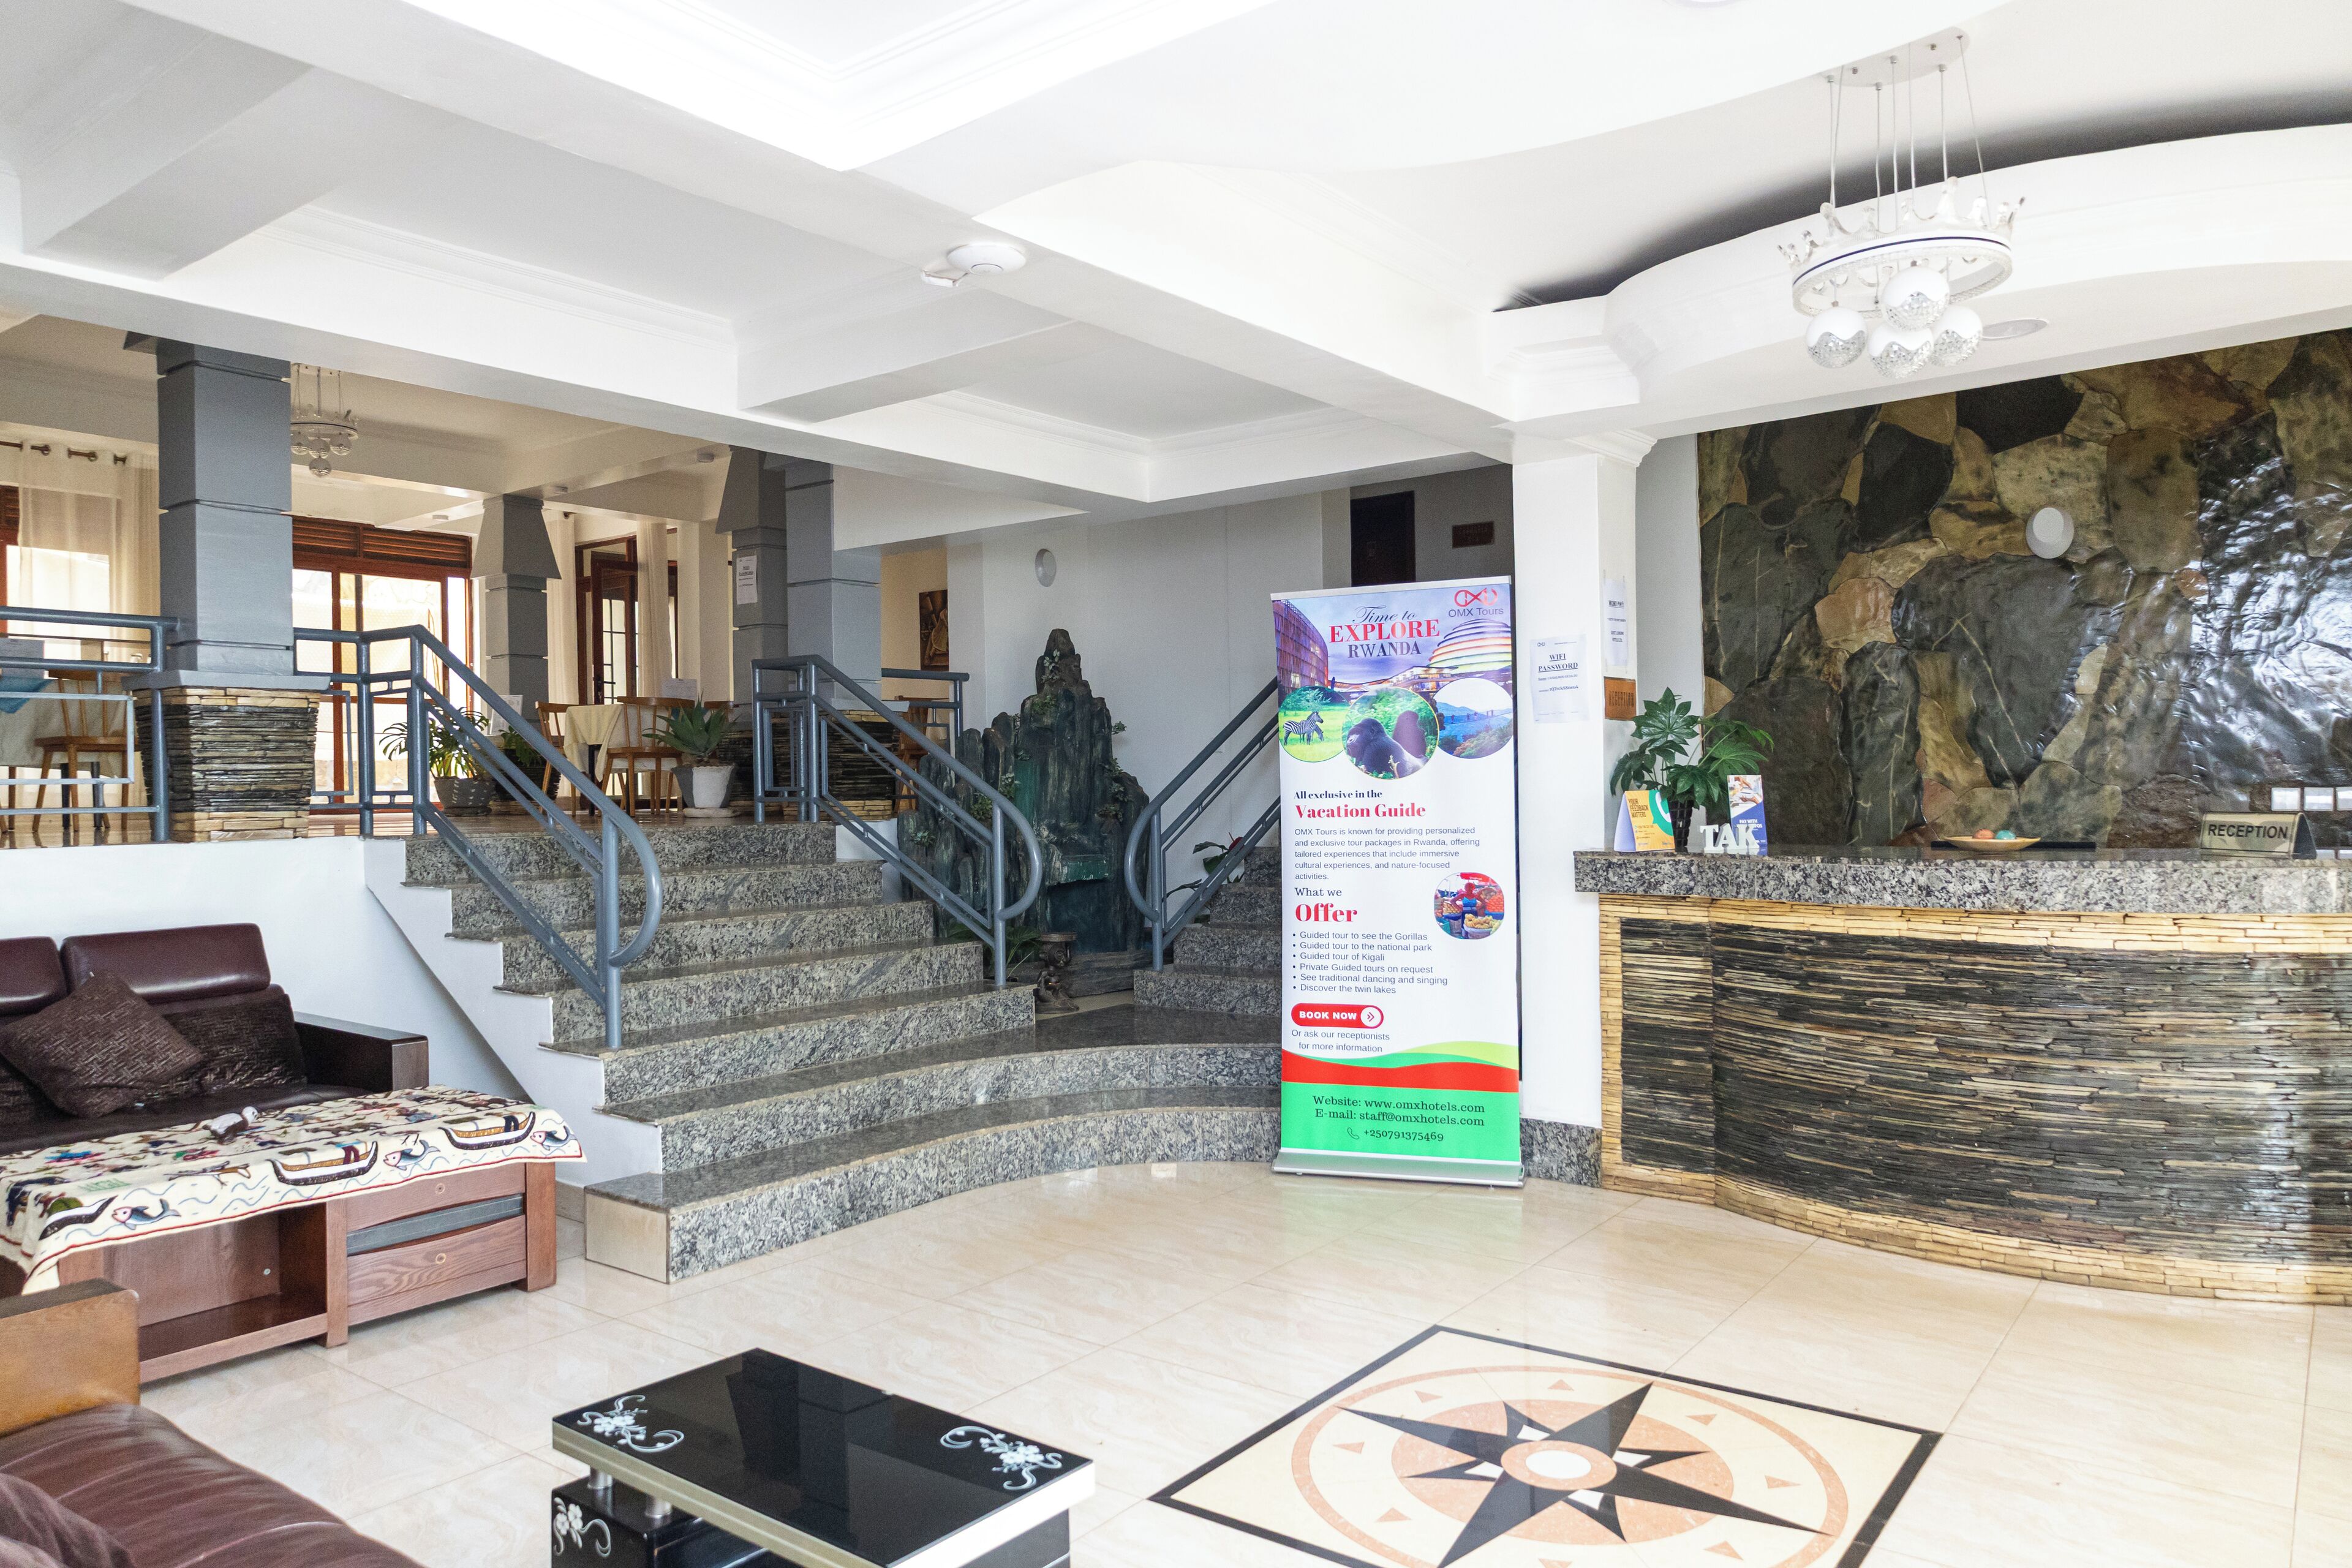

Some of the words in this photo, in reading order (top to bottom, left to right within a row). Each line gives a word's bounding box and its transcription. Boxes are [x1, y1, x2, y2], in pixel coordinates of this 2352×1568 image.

[1352, 605, 1398, 624] Time
[1402, 610, 1417, 620] to
[1448, 608, 1473, 617] OMX
[1476, 606, 1504, 616] Tours
[1329, 619, 1440, 643] EXPLORE
[1348, 642, 1421, 658] RWANDA
[1538, 663, 1578, 672] PASSWORD
[1295, 804, 1370, 818] Vacation
[1374, 803, 1426, 817] Guide
[1387, 827, 1423, 836] providing
[1425, 827, 1475, 836] personalized
[1700, 823, 1760, 850] TAK
[2208, 824, 2288, 839] RECEPTION
[1365, 839, 1401, 848] packages
[1450, 838, 1480, 846] offering
[1295, 887, 1324, 896] What
[1295, 902, 1358, 922] Offer
[1413, 943, 1432, 953] park
[1362, 953, 1384, 962] Kigali
[1401, 966, 1433, 974] request
[1362, 975, 1395, 984] dancing
[1417, 976, 1448, 986] singing
[1337, 1031, 1390, 1041] receptionists
[1336, 1044, 1382, 1052] information
[1313, 1095, 1362, 1106] Website:
[1365, 1099, 1485, 1113] www.omxhotels.com
[1315, 1109, 1356, 1120] E-mail:
[1359, 1112, 1484, 1126] staff@omxhotels.com
[1364, 1130, 1444, 1142] +250791375469
